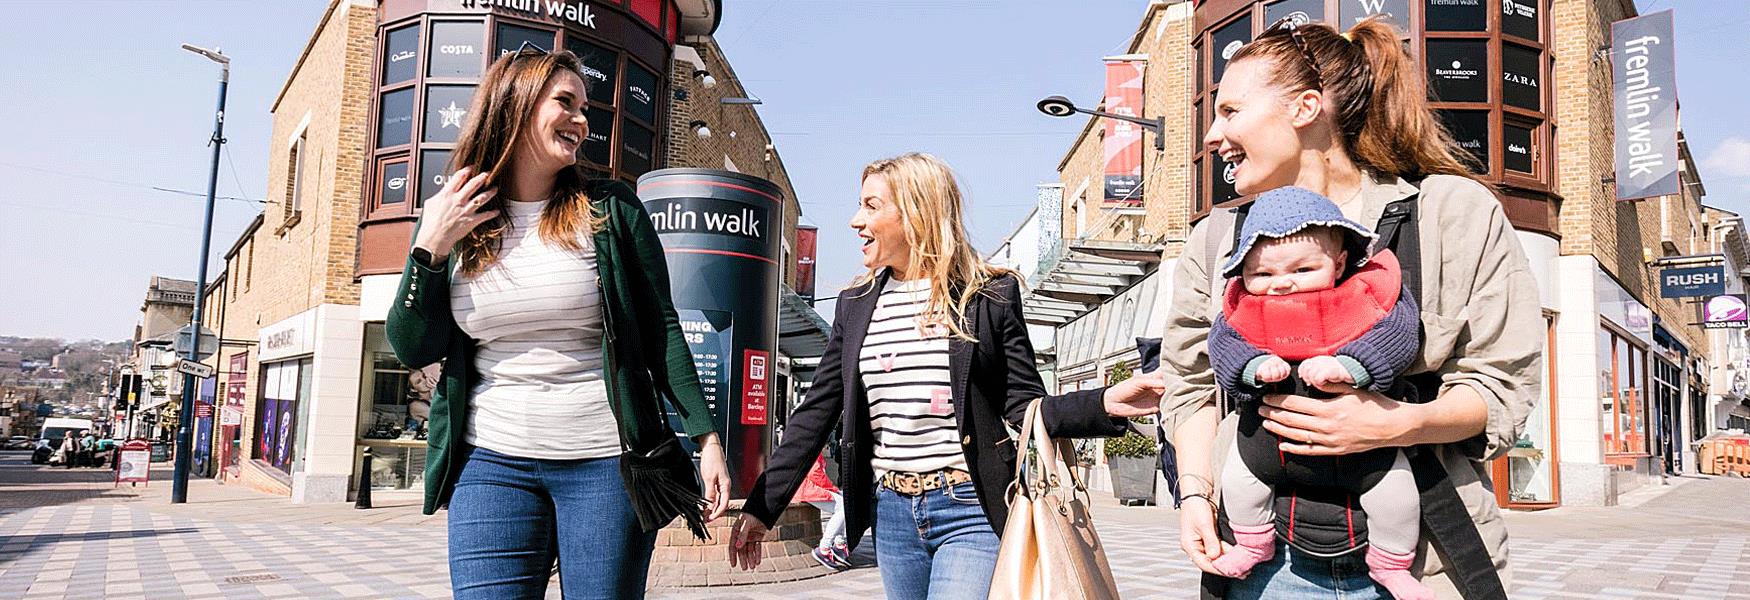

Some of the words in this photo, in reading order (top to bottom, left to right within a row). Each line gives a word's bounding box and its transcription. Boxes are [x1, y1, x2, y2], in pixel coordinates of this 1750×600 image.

[545, 0, 596, 29] walk
[440, 44, 474, 55] COSTA
[1504, 72, 1537, 87] ZARA
[1625, 36, 1661, 119] fremlin
[1628, 121, 1664, 179] walk
[650, 202, 696, 231] mlin
[704, 208, 760, 238] walk
[1666, 272, 1719, 287] RUSH
[684, 332, 705, 344] RS
[182, 363, 196, 371] One
[930, 388, 951, 414] E
